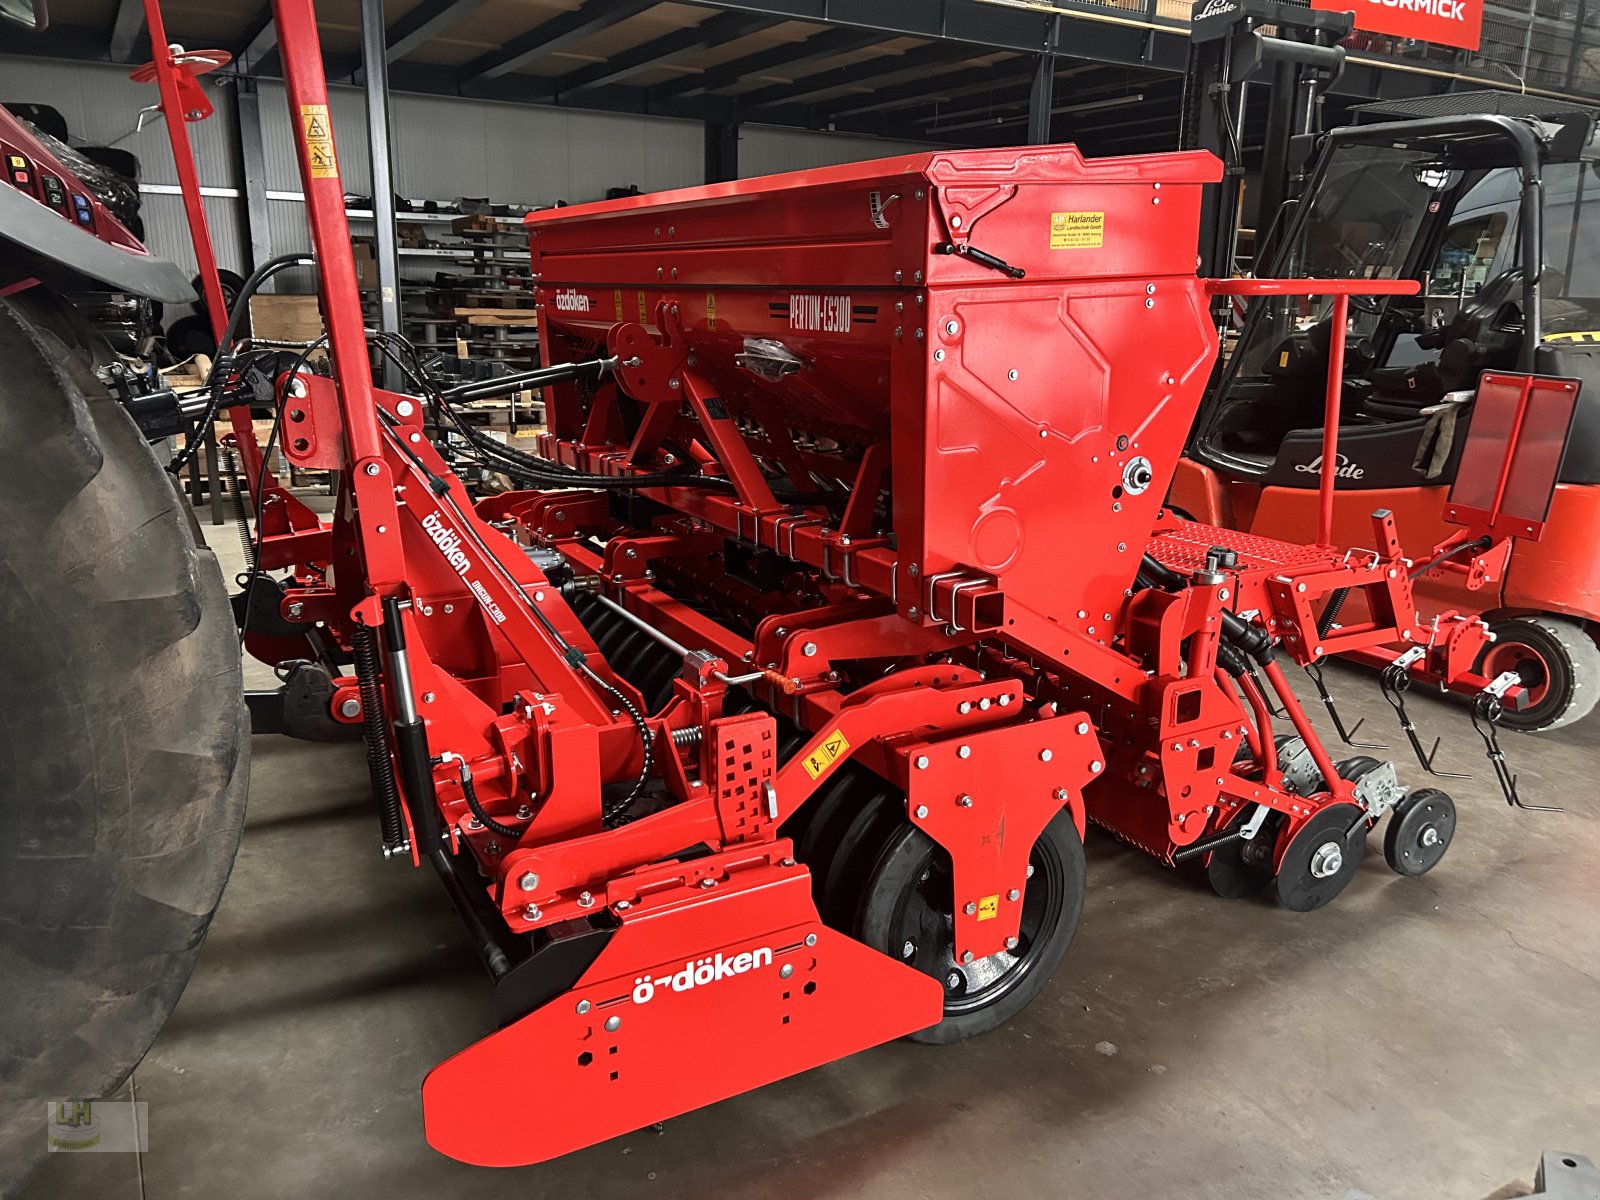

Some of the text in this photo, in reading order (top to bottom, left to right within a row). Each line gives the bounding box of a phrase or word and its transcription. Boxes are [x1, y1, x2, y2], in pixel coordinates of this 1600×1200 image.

[1194, 0, 1237, 21] Linde
[1368, 0, 1466, 21] RMICK
[1067, 214, 1102, 223] Harlander
[556, 288, 590, 312] özdöken
[789, 294, 851, 333] PERTUM-CS300
[1294, 453, 1364, 479] Lde
[421, 510, 471, 576] özdöken
